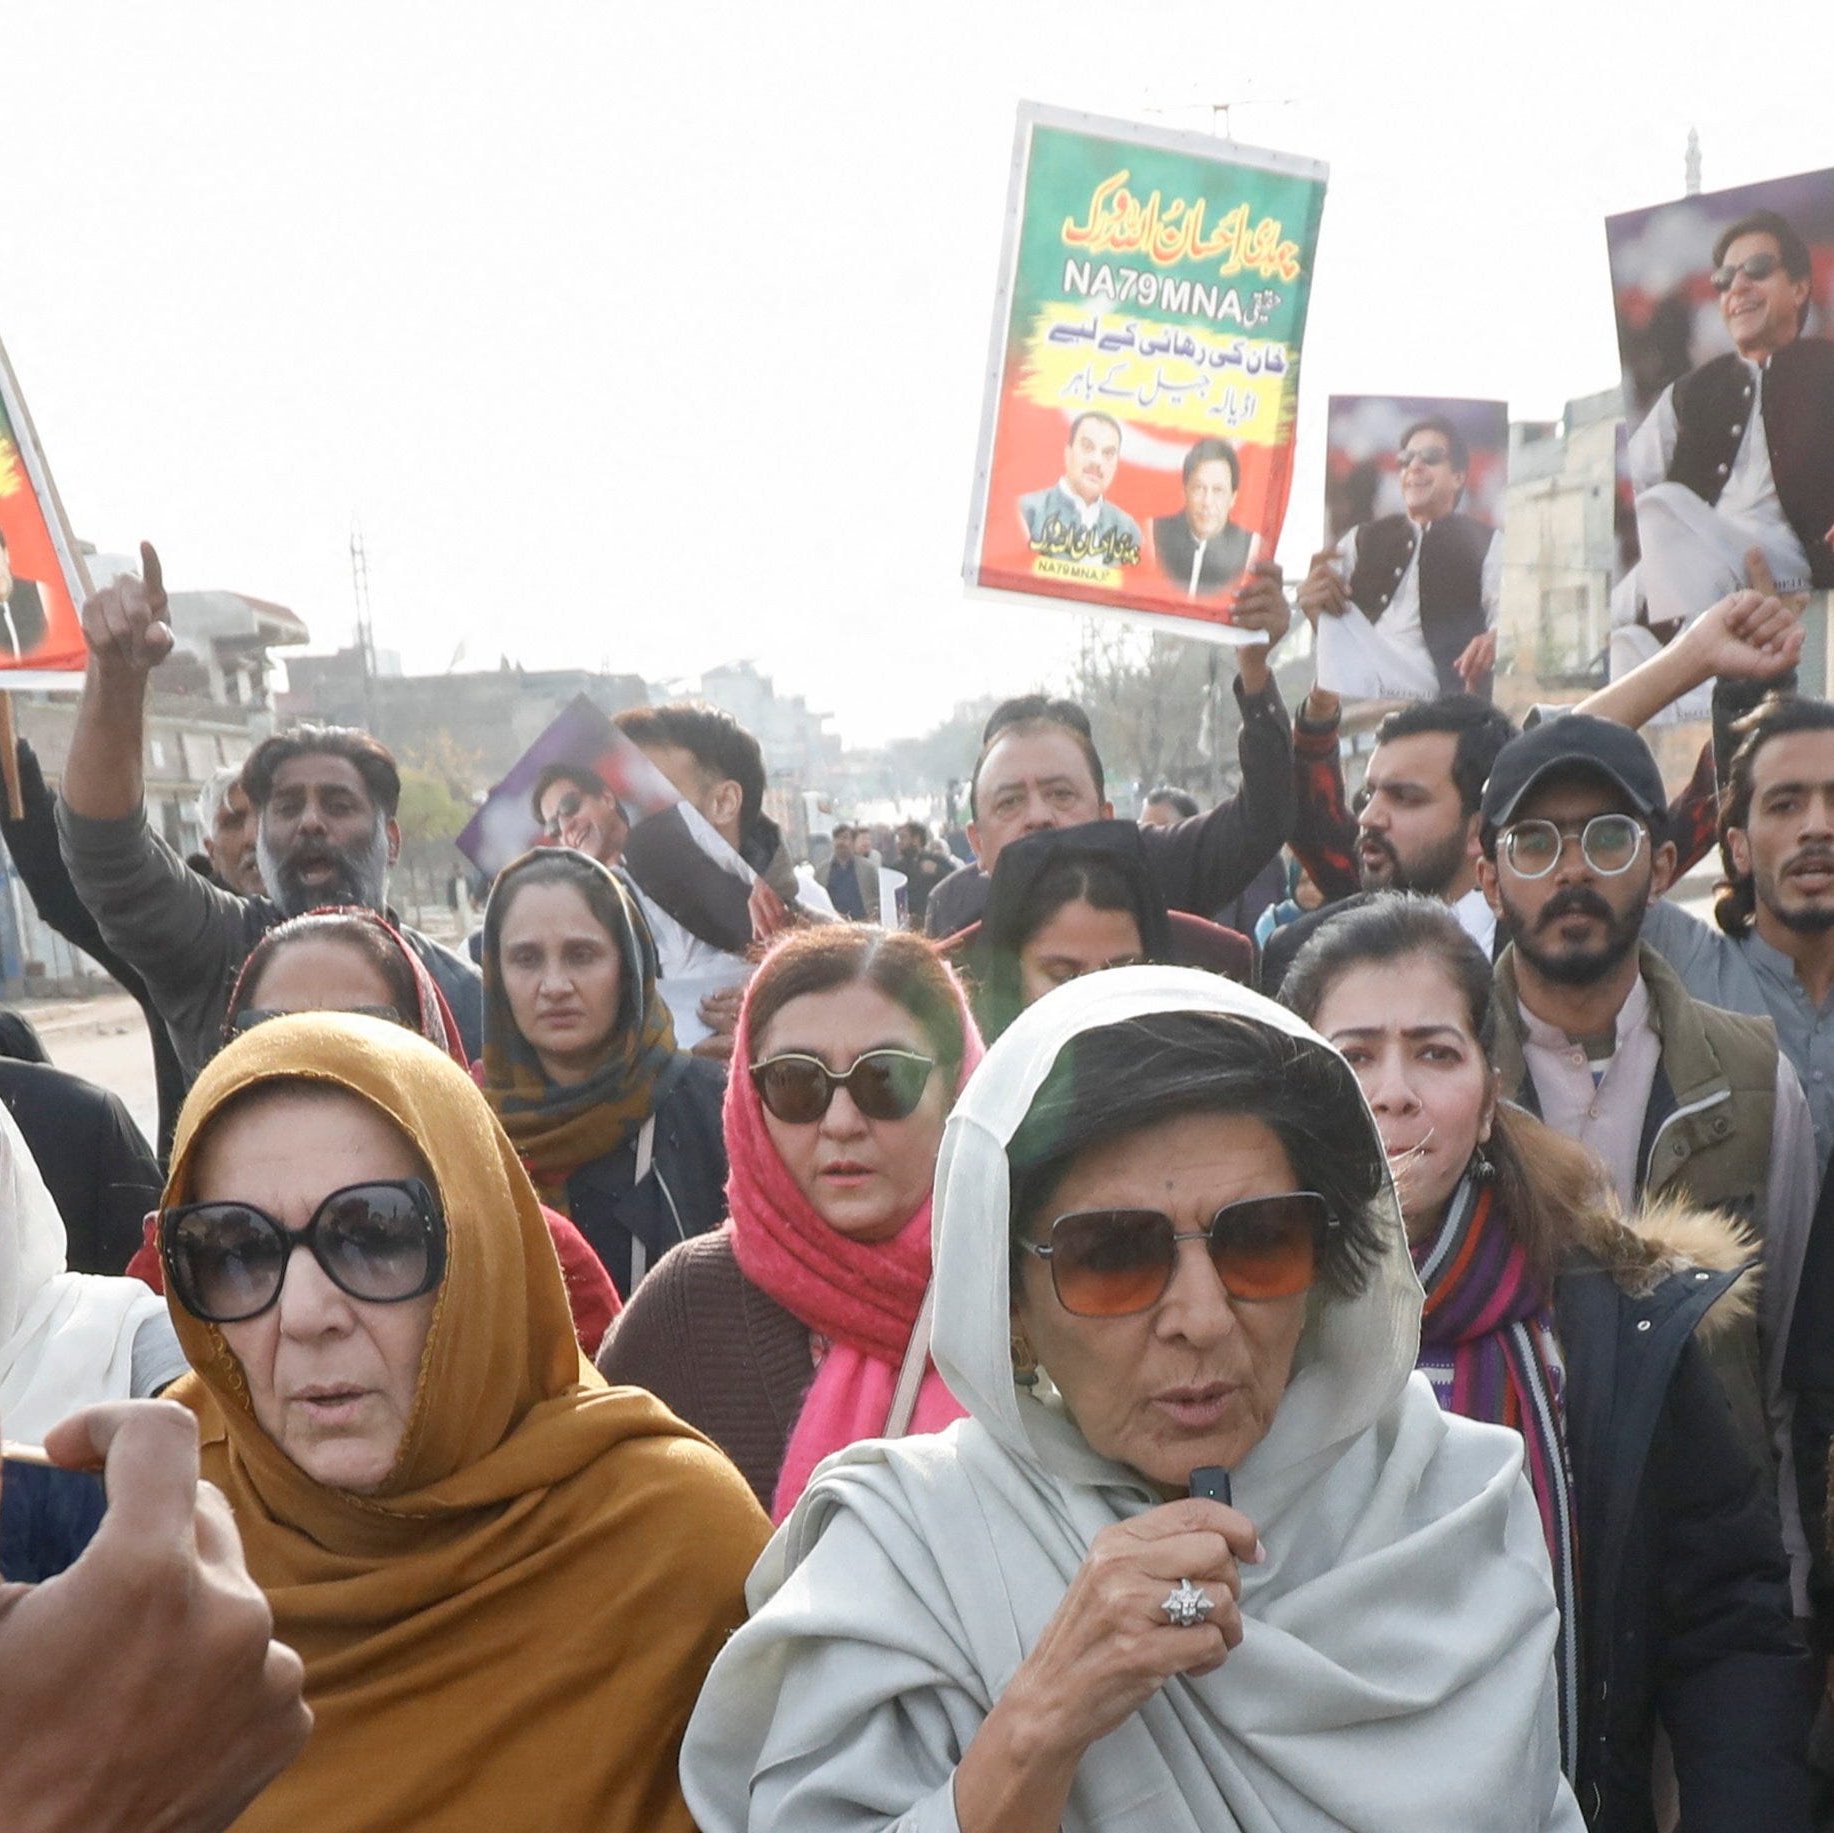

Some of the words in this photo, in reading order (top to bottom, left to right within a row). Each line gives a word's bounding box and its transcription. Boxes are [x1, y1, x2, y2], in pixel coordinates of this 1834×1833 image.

[1097, 321, 1137, 351] کے
[1208, 340, 1245, 368] کی
[1246, 344, 1286, 375] خان
[1138, 368, 1211, 407] جیل
